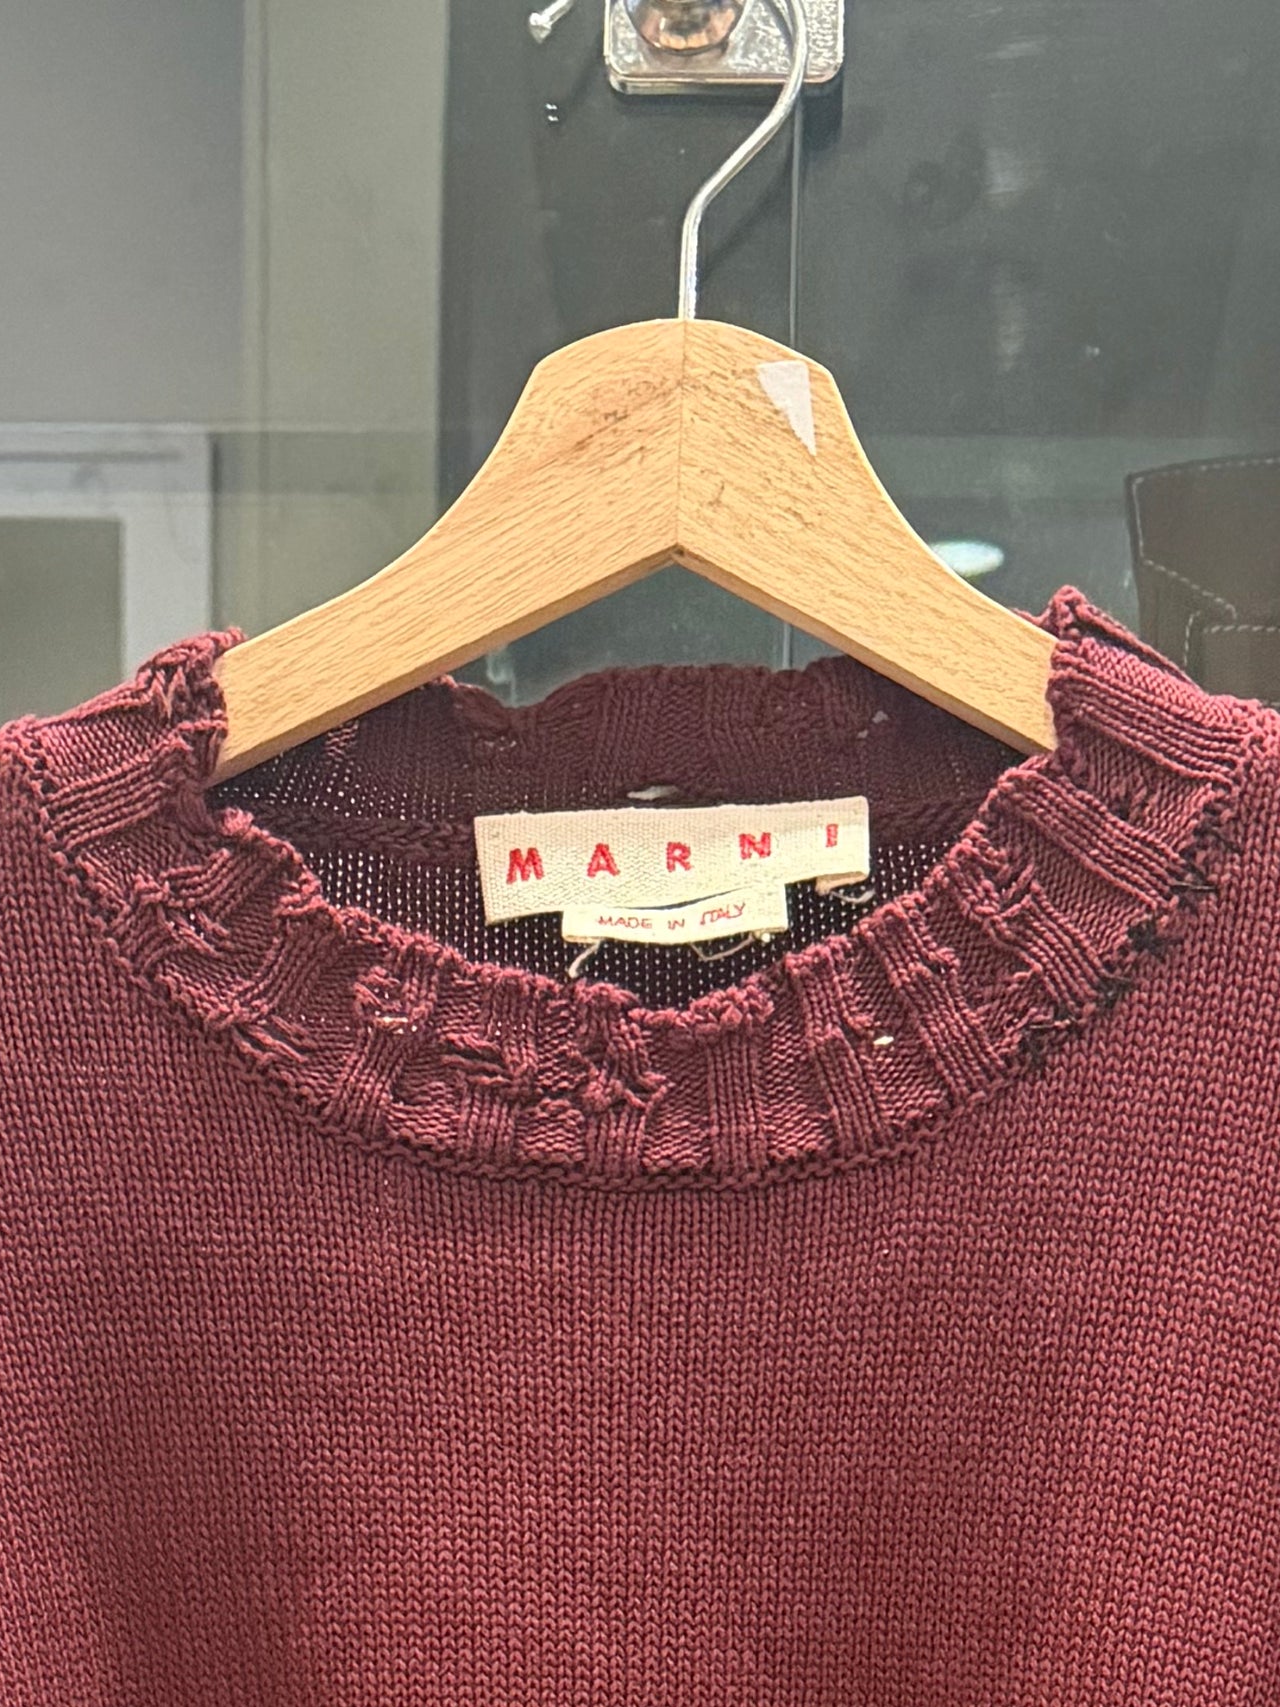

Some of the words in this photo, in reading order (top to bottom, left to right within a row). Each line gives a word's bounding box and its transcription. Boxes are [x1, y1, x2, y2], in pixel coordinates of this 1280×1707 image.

[506, 823, 838, 884] MARNI
[598, 915, 653, 930] MADE
[667, 917, 686, 931] IN
[699, 901, 746, 927] ITALY
